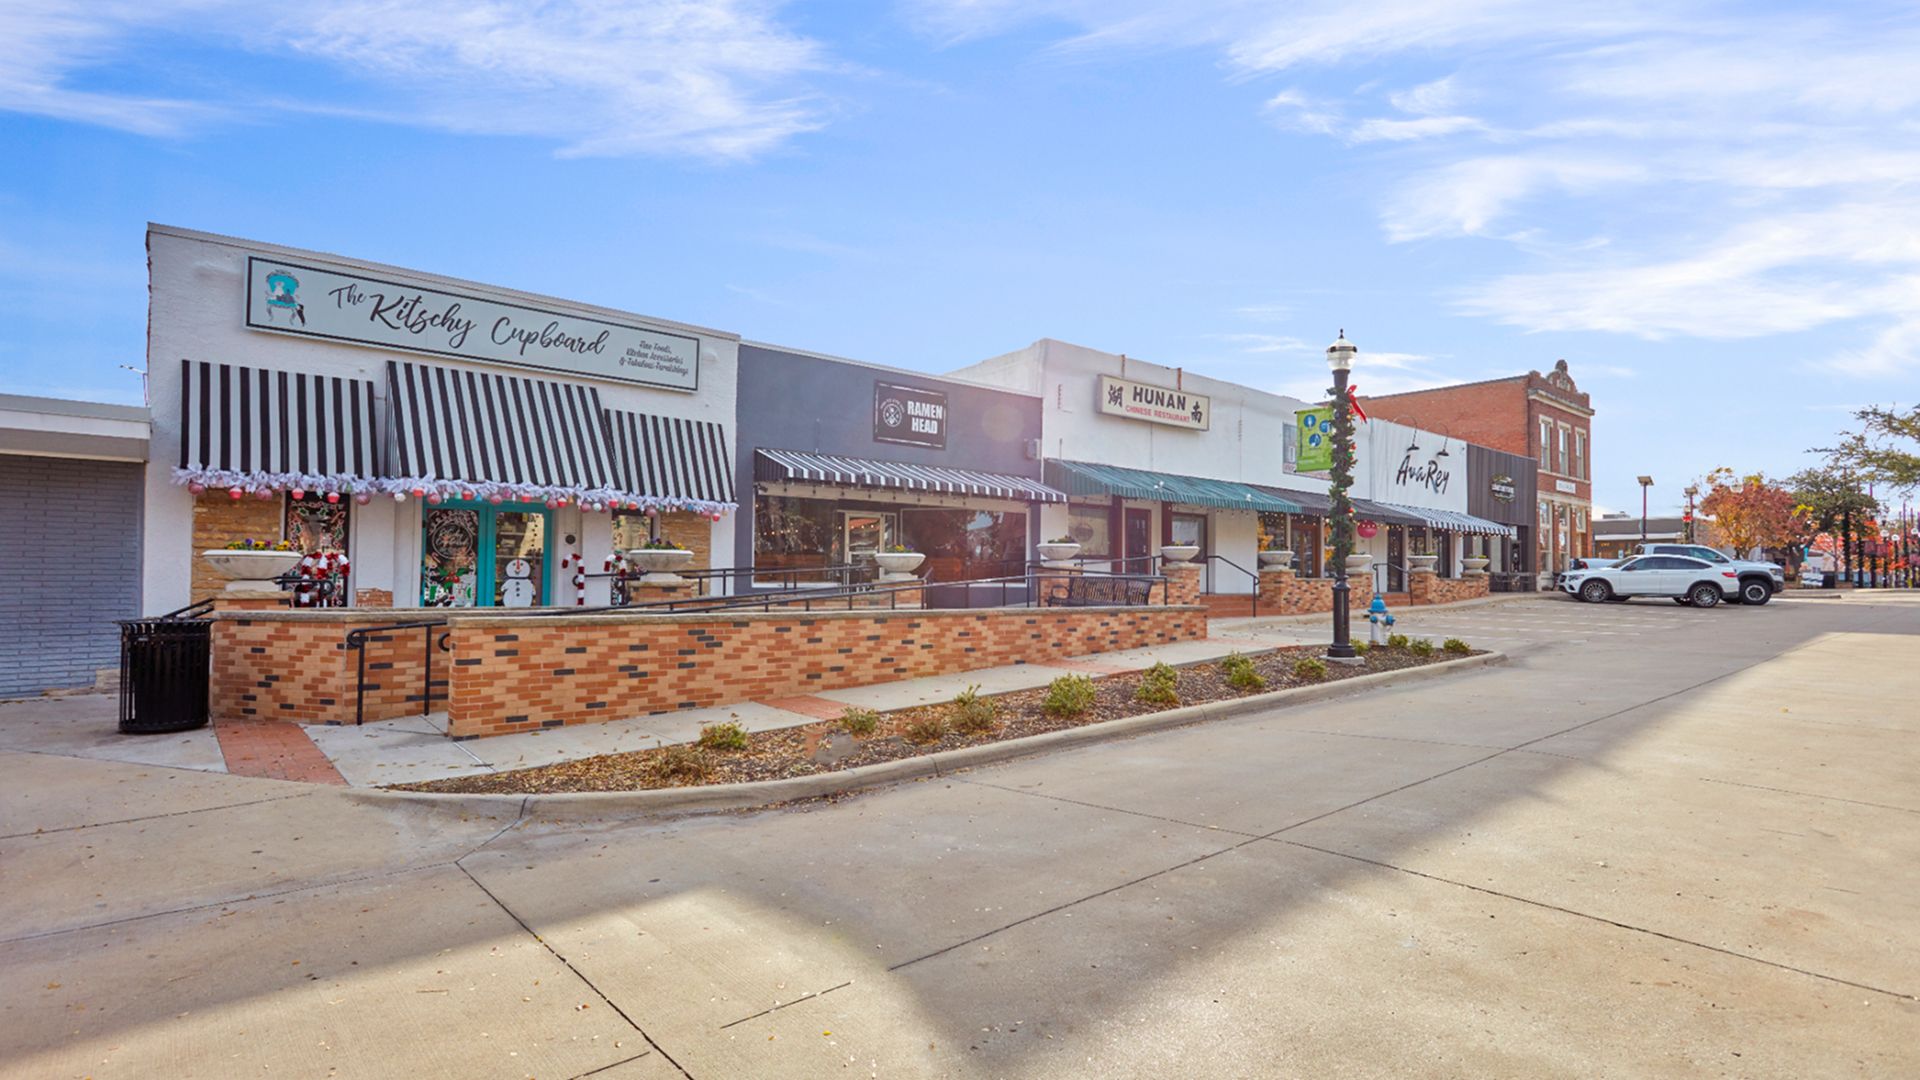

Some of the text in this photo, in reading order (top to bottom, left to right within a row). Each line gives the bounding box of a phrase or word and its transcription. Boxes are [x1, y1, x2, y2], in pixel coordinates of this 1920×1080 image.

[328, 283, 610, 356] The Kitschy Cupboard
[626, 347, 649, 359] Kitchen
[1132, 385, 1187, 411] HUNAN
[907, 400, 943, 420] RAMEN
[1125, 404, 1191, 424] CHINESE RESTAURANT
[911, 416, 939, 435] HEAD
[1396, 454, 1450, 495] AvaRey
